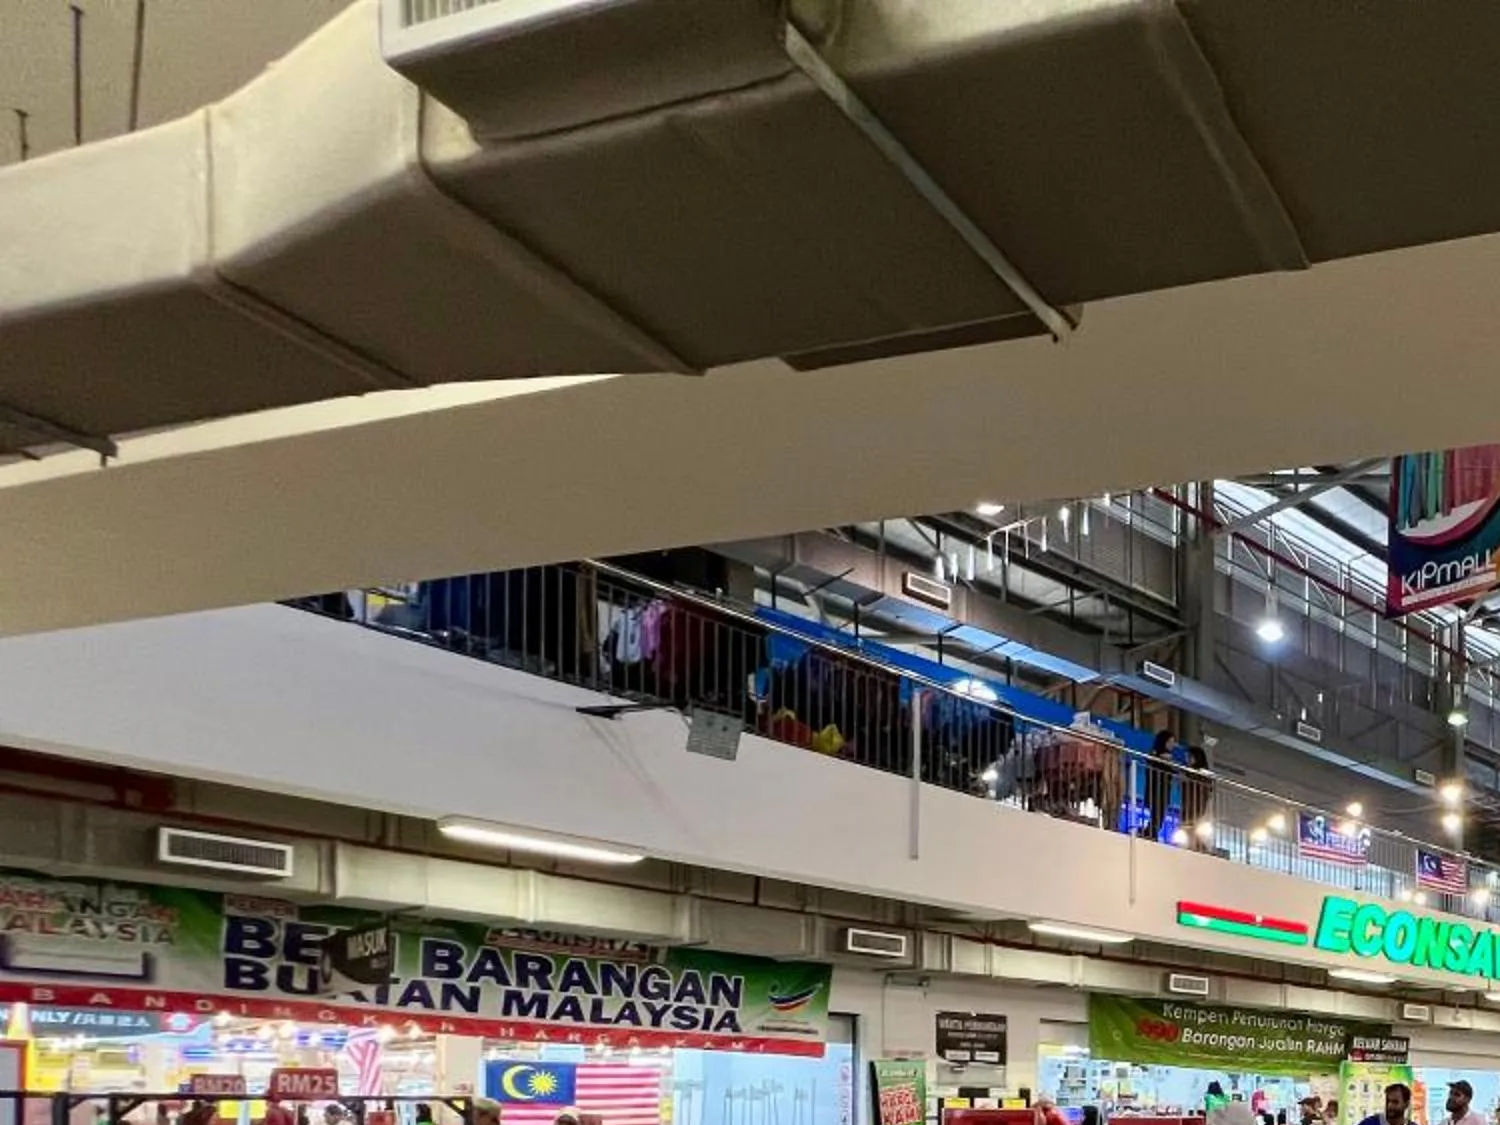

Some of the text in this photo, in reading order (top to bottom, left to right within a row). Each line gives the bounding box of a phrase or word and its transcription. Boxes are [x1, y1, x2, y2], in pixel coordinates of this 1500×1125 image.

[421, 938, 743, 1009] BARANGAN
[501, 988, 743, 1034] MALAYSIA
[277, 1072, 337, 1094] RM25
